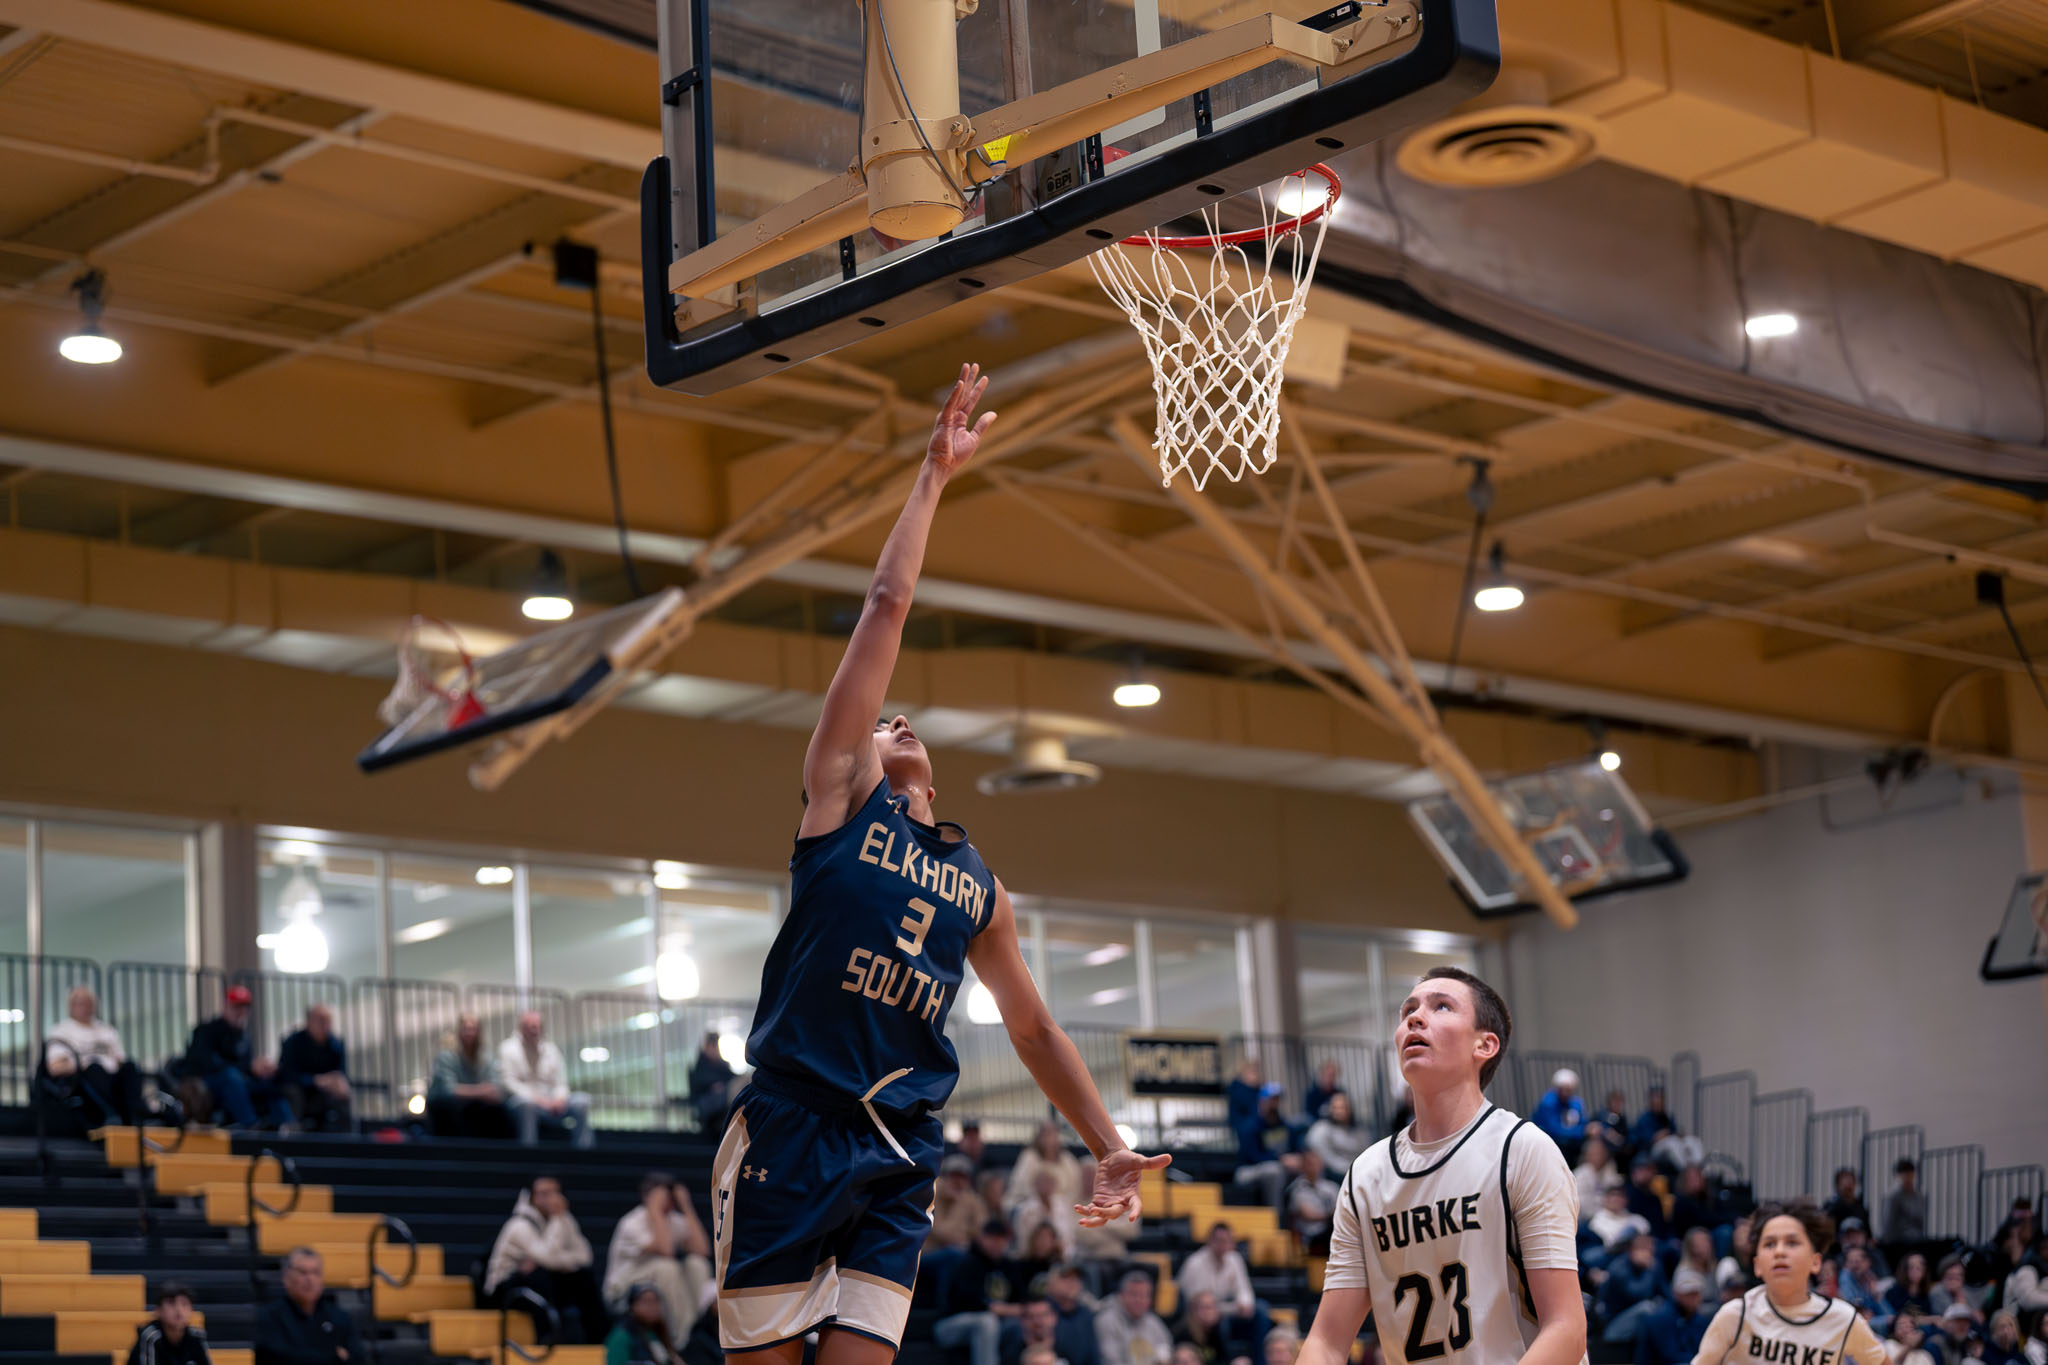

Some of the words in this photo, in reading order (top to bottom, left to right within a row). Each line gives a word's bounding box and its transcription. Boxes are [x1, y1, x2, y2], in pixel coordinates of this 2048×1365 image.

[1055, 173, 1072, 189] BPI
[858, 821, 987, 926] ELKHORN
[895, 897, 936, 957] 3
[841, 947, 947, 1024] SOUTH
[1371, 1192, 1482, 1253] BURKE
[1394, 1260, 1474, 1363] 23
[1749, 1335, 1835, 1365] BURKE
